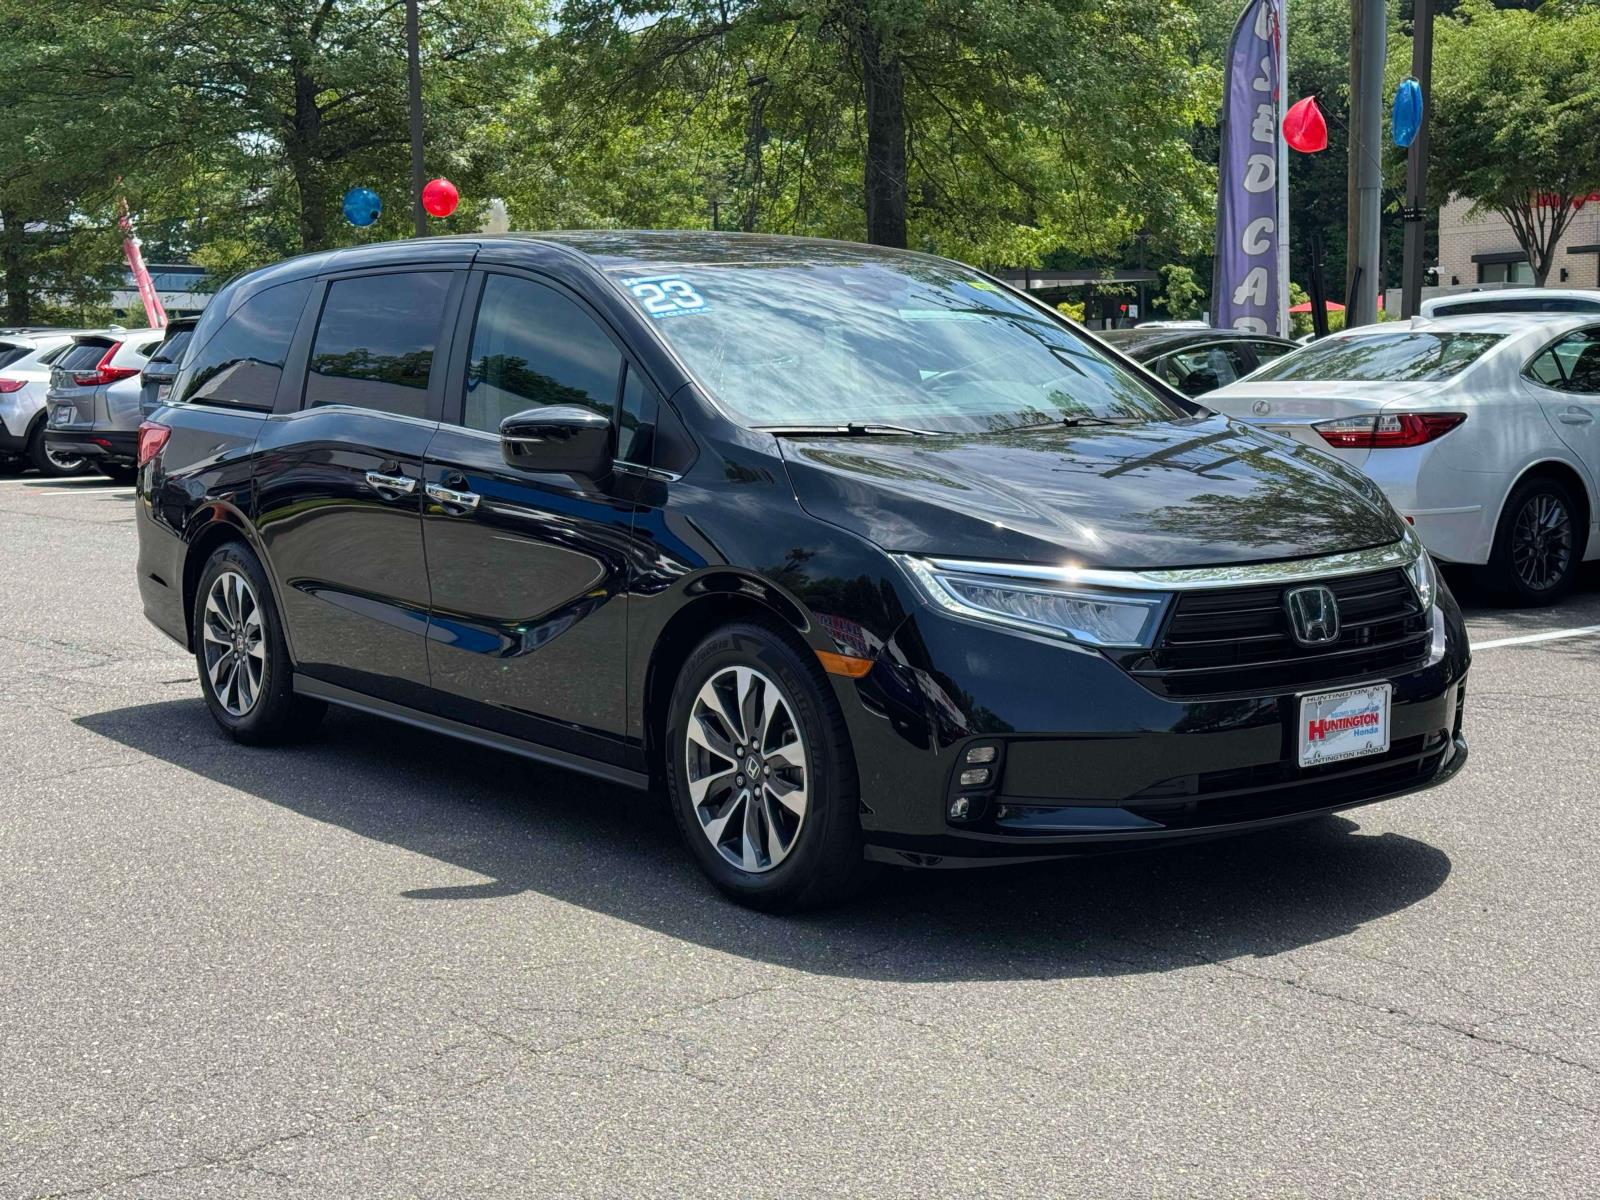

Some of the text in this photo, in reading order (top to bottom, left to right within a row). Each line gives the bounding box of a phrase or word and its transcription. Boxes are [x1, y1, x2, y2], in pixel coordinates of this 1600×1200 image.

[632, 280, 705, 313] 23
[1309, 712, 1379, 741] HUNTINGTON
[1353, 727, 1379, 737] Honda
[1304, 747, 1384, 765] HUNTINGTON HONDA
